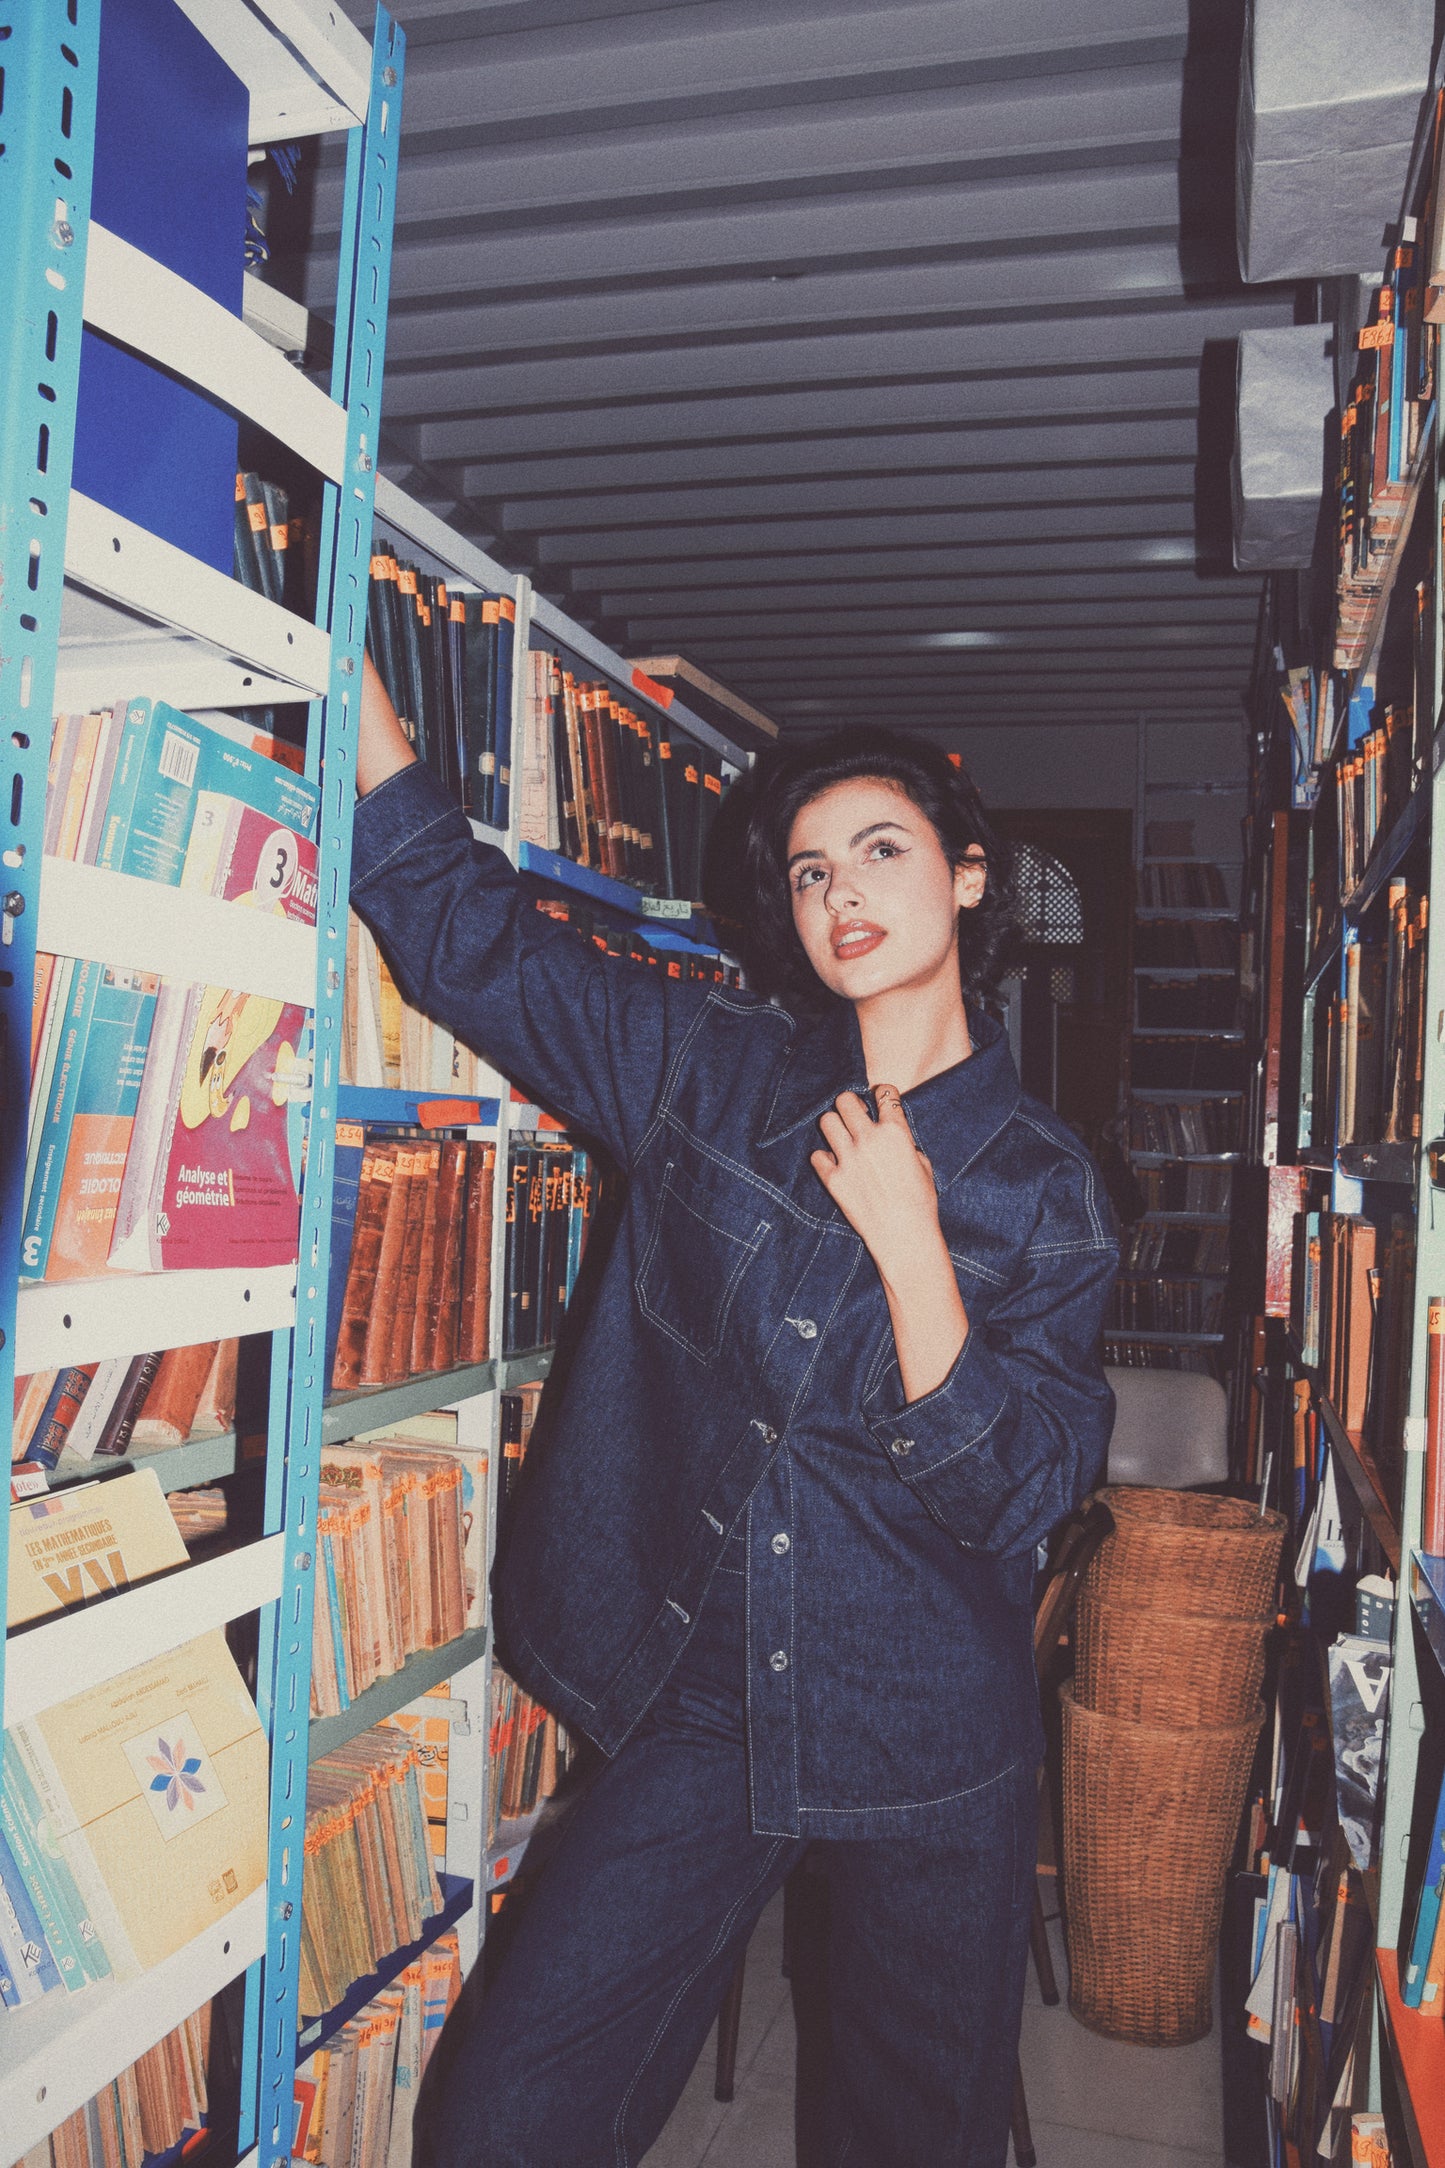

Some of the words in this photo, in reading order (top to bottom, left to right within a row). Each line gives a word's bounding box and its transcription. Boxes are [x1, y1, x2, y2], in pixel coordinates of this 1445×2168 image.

[270, 848, 288, 888] 3
[42, 1144, 56, 1192] Enseignement
[178, 1165, 218, 1188] Analyse
[217, 1170, 228, 1186] et
[176, 1186, 229, 1208] géométrie
[34, 1195, 46, 1232] secondaire
[23, 1235, 42, 1266] 3
[25, 1540, 43, 1558] LES
